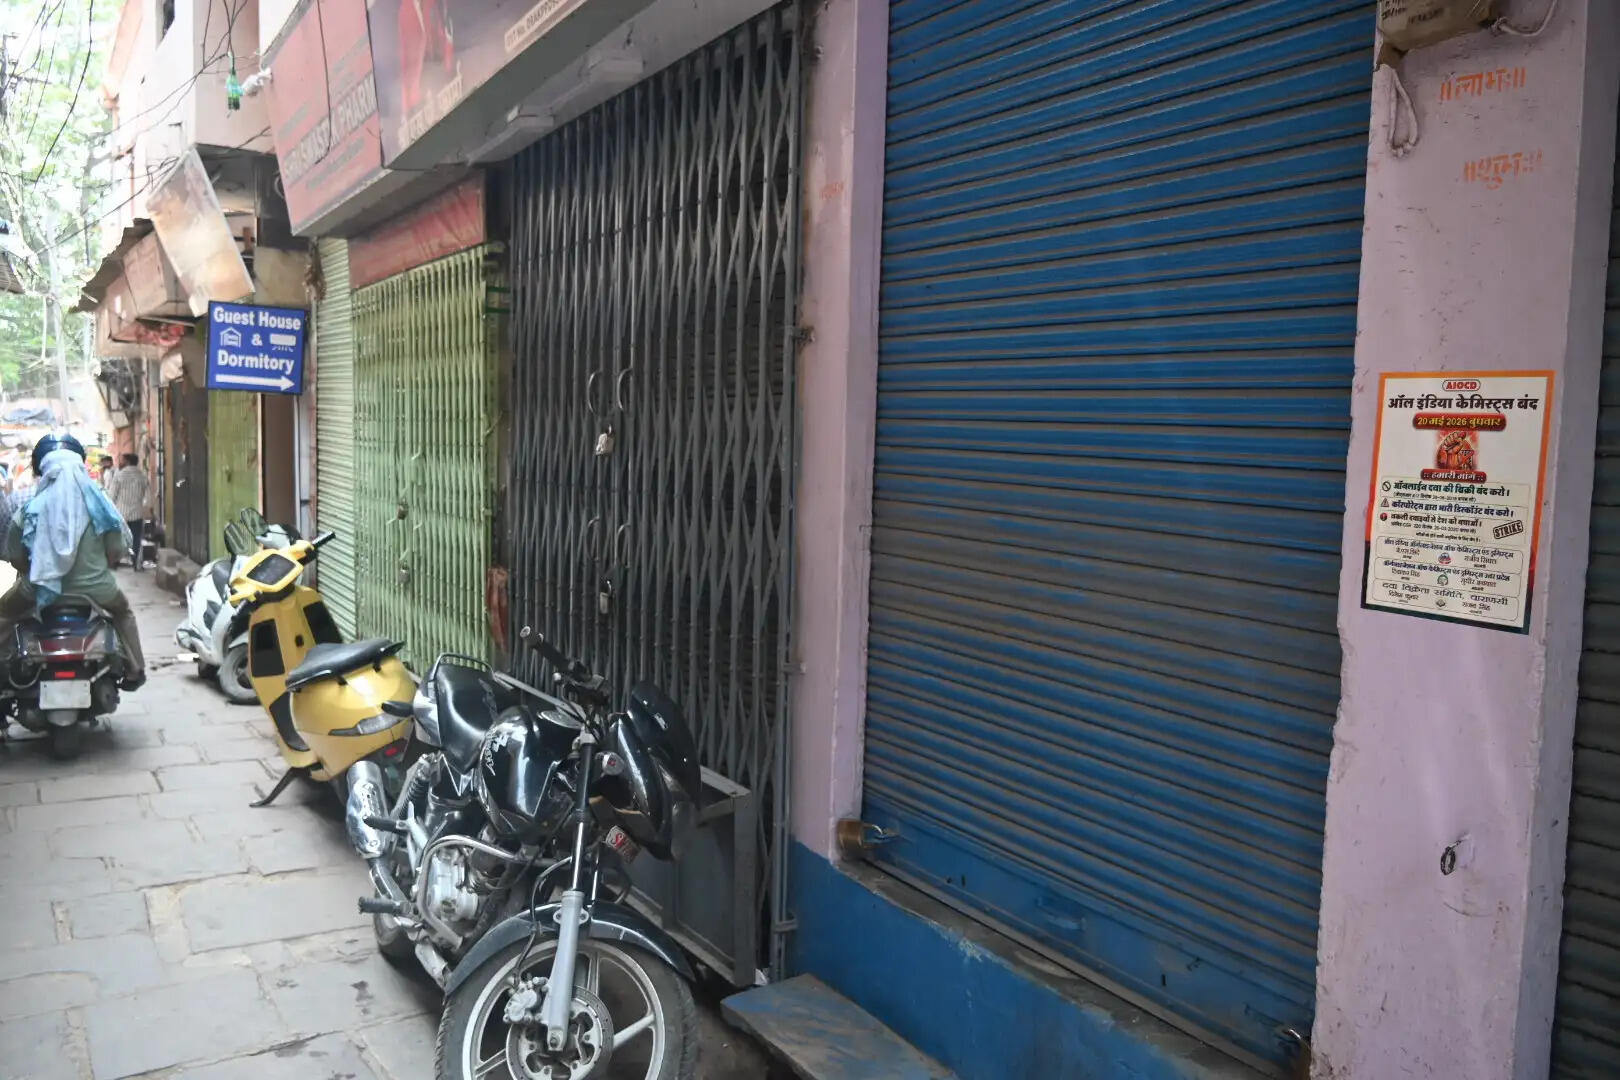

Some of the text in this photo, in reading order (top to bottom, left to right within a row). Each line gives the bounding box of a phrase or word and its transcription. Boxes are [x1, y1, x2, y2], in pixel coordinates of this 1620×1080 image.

[213, 306, 302, 330] Guest House
[251, 333, 263, 346] &
[217, 349, 295, 375] Dormitory
[1388, 393, 1540, 413] ऑल इंडिया केमिस्ट्स बंद
[1429, 416, 1444, 426] मई
[1446, 418, 1467, 426] 2026
[1494, 522, 1522, 538] STRIKE
